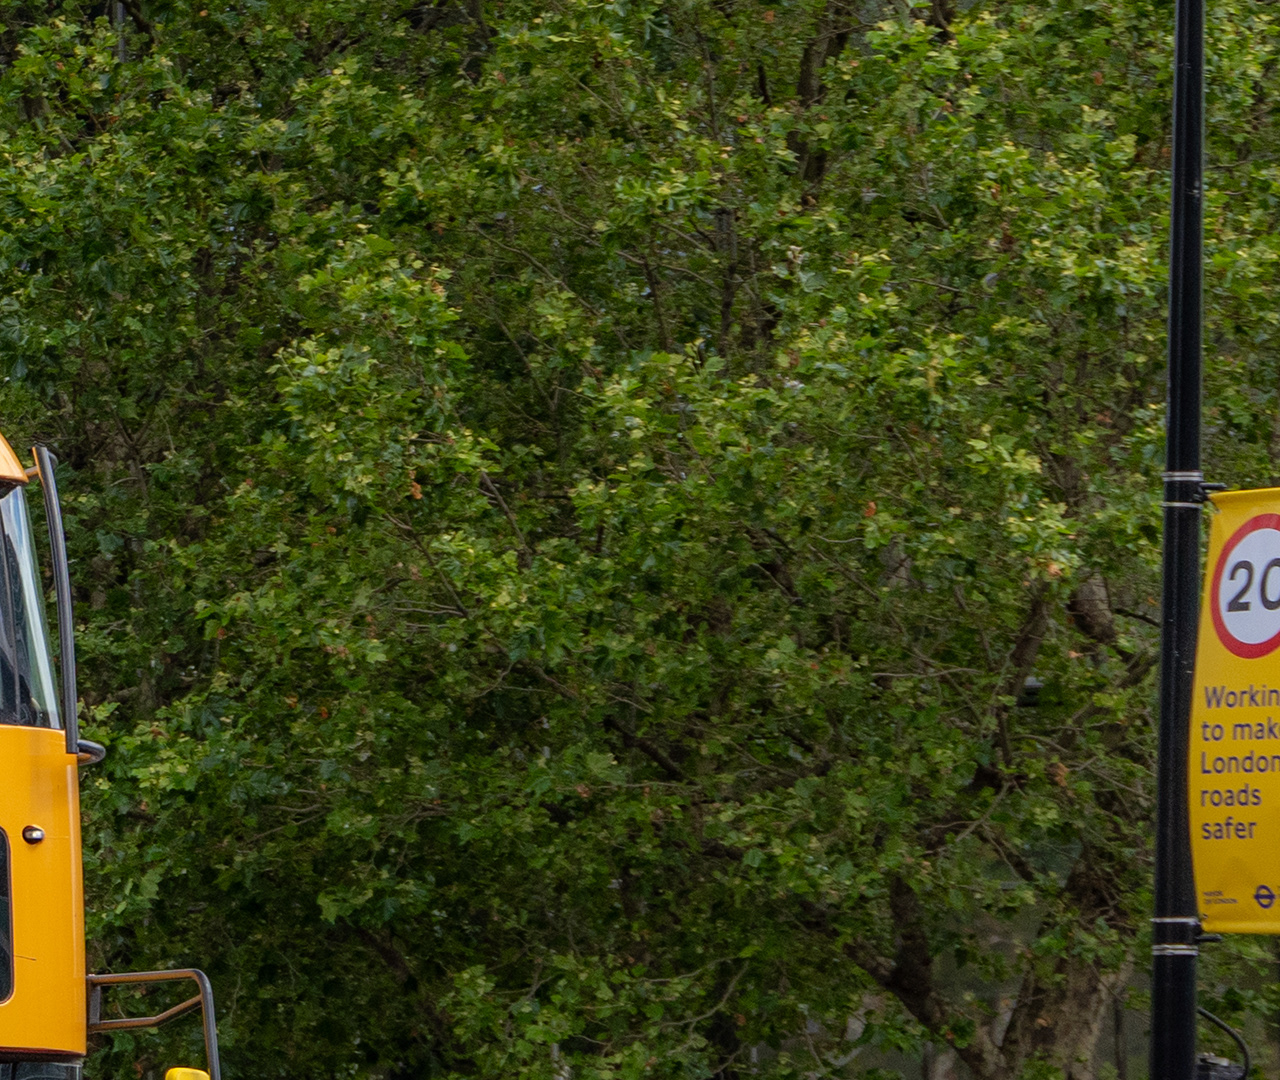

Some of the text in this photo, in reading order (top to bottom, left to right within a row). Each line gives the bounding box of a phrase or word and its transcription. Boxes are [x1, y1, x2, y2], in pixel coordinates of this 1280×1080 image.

[1227, 557, 1280, 613] 20
[1201, 721, 1225, 741] to
[1201, 750, 1280, 774] London
[1201, 783, 1263, 807] roads
[1202, 816, 1257, 840] safer
